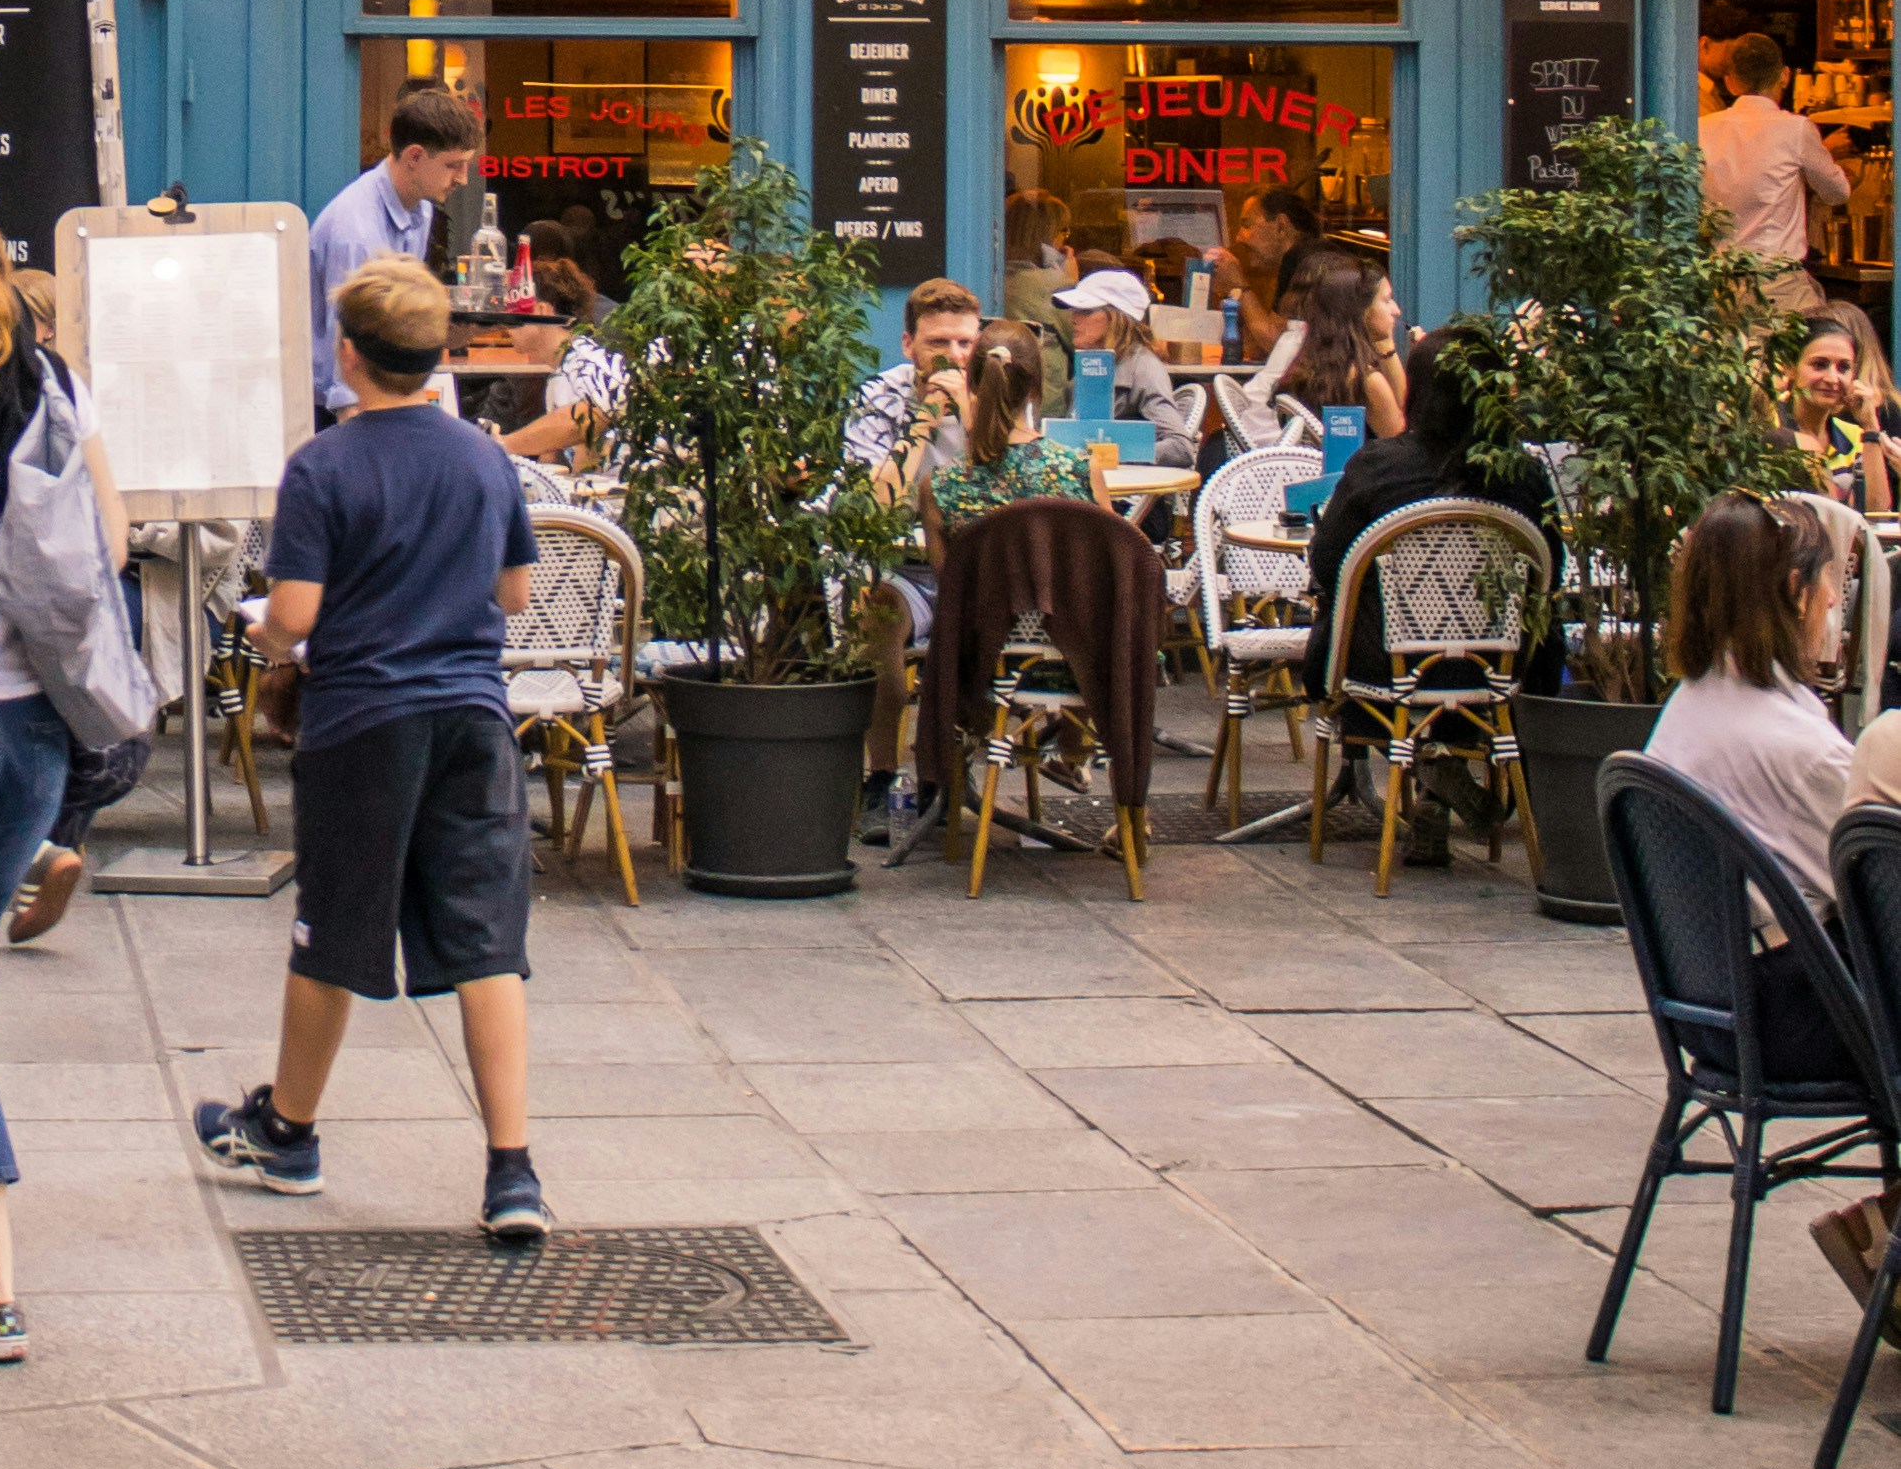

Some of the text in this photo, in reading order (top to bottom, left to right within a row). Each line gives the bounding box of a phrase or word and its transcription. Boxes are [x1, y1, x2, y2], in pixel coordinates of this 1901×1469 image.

[849, 43, 910, 60] DEJEUNER
[1529, 57, 1600, 87] SPRITZ
[861, 87, 898, 104] DINER
[505, 95, 571, 119] LES
[590, 99, 706, 147] JOURS
[1043, 79, 1357, 146] DEJEUNER
[848, 131, 910, 149] PLANCHES
[477, 155, 632, 179] BISTROT
[1125, 147, 1288, 184] DINER
[858, 176, 899, 193] APERO
[893, 220, 923, 238] VINS
